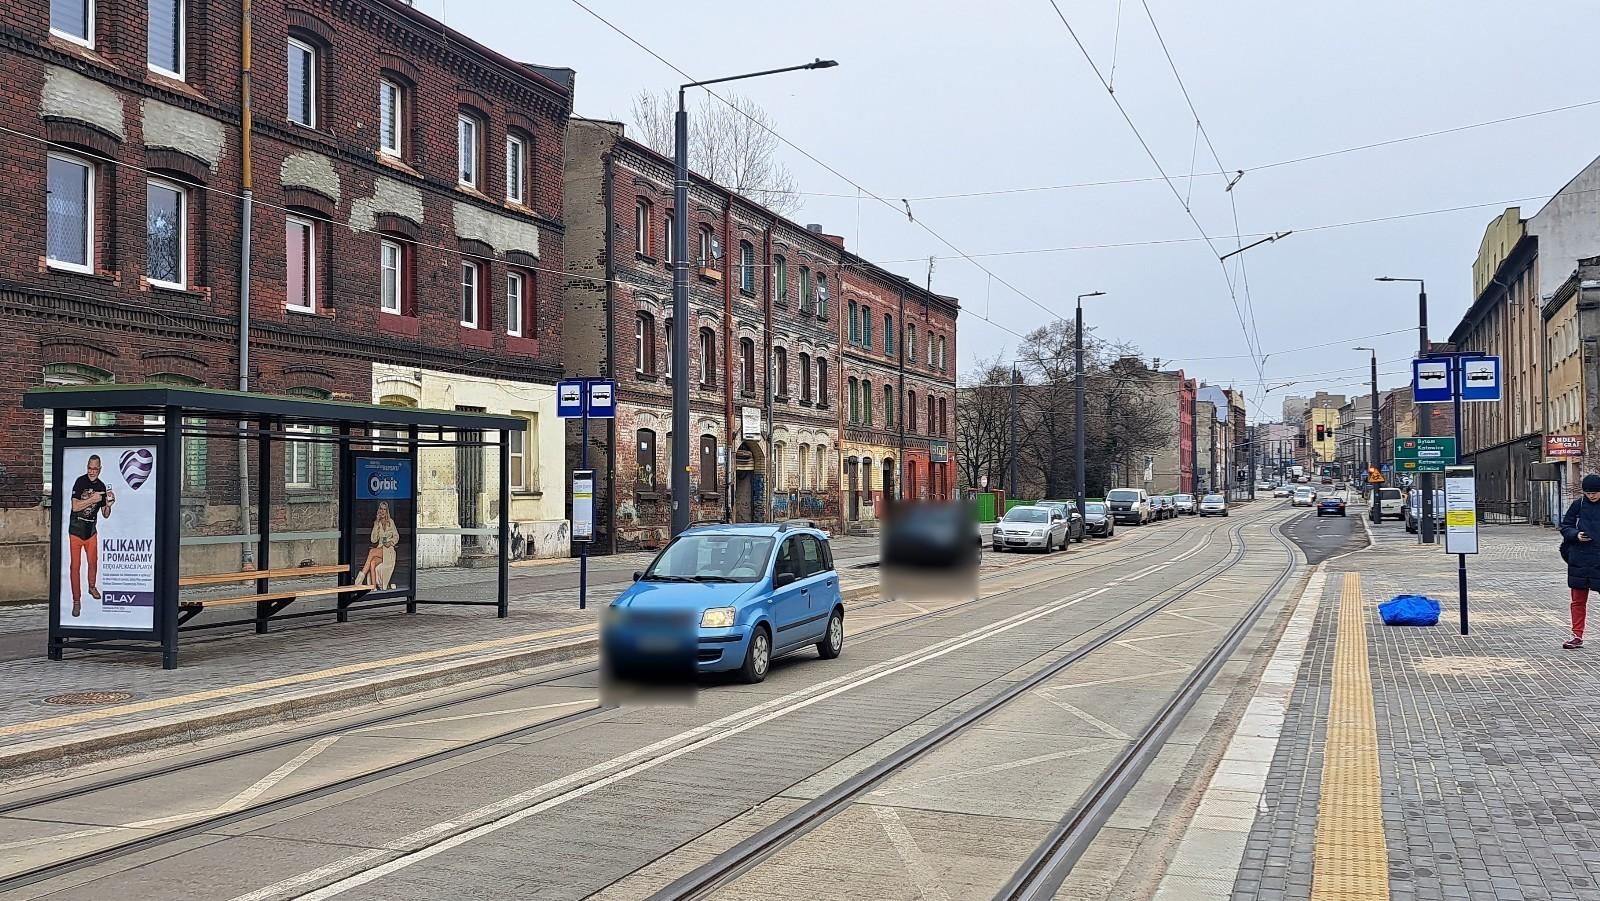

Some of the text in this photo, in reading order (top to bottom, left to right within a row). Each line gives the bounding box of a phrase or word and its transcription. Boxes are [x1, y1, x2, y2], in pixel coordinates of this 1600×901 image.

[371, 477, 397, 491] Orbit
[103, 539, 152, 552] KLIKAMY
[102, 553, 152, 562] I POMAGAMY
[105, 594, 136, 603] PLAY
